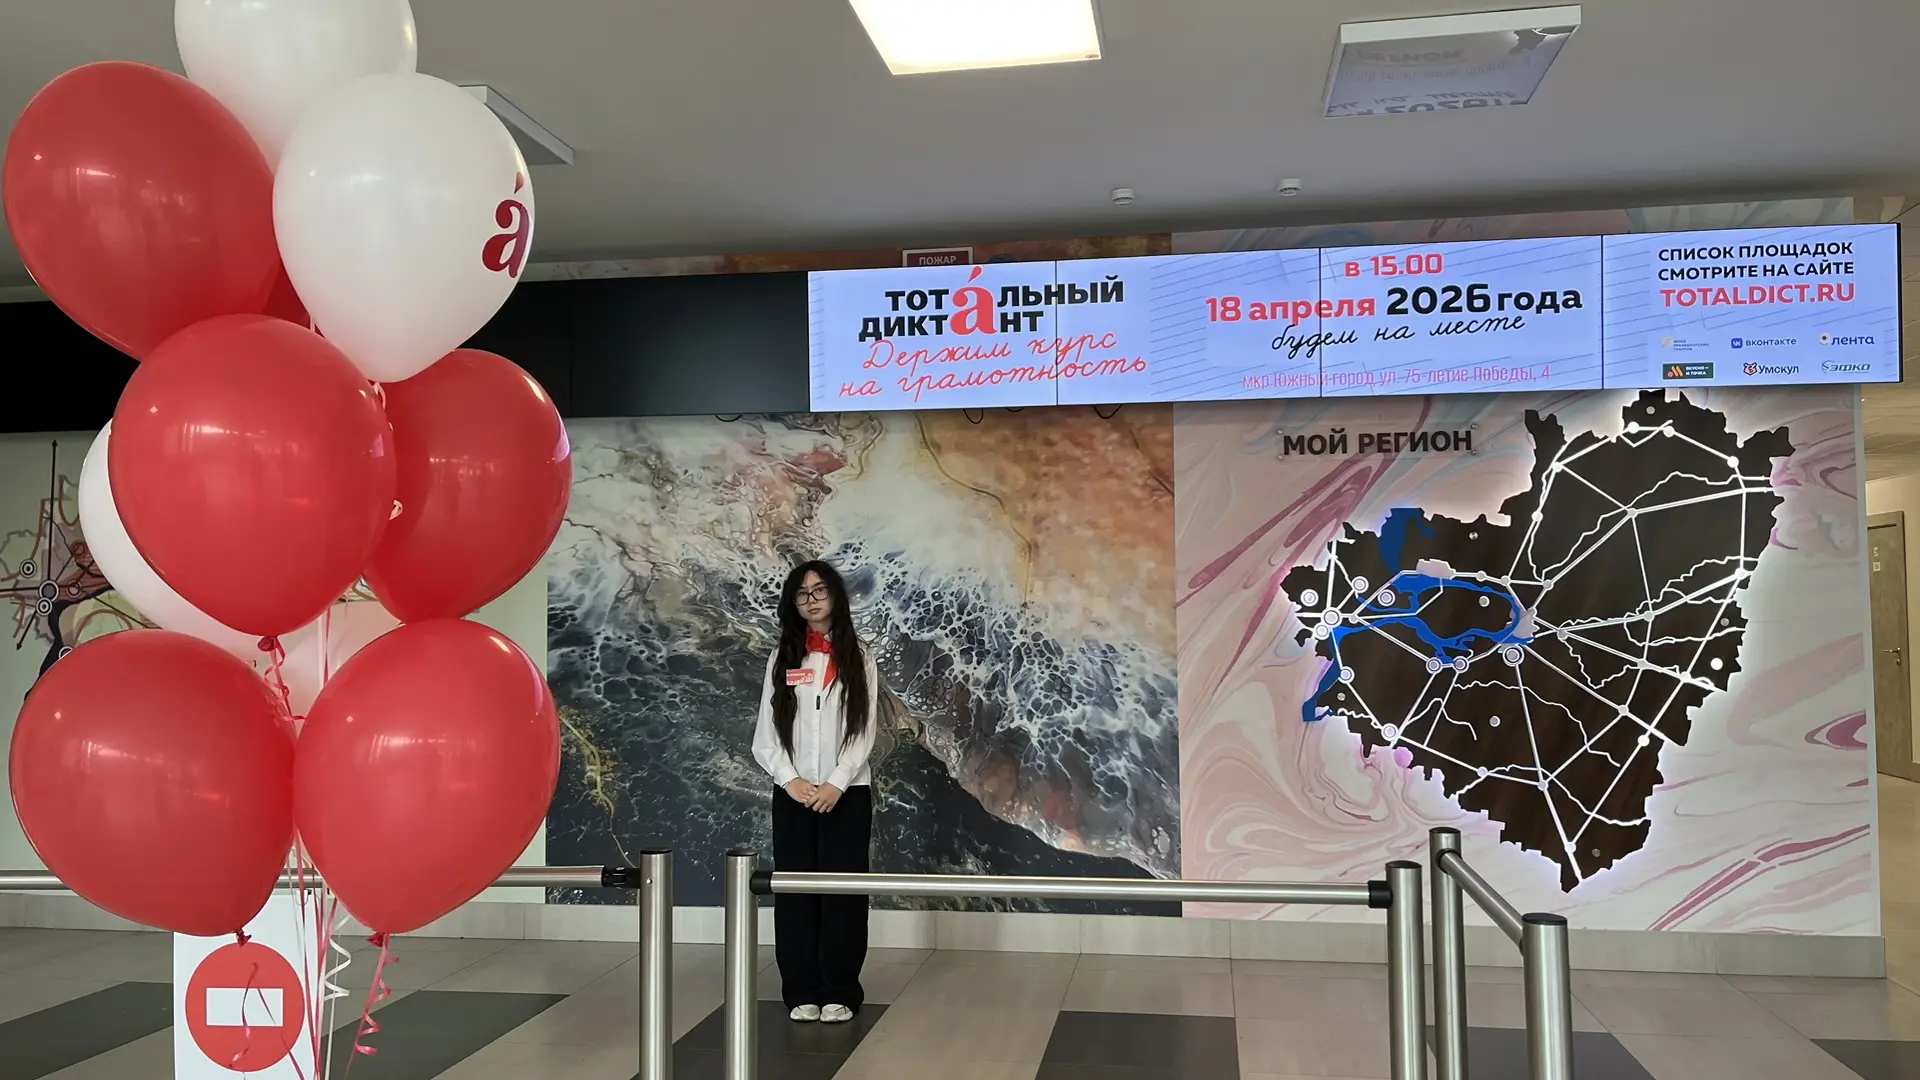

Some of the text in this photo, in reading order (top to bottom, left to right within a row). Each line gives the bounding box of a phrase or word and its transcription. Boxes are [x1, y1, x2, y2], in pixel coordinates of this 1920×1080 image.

[919, 255, 957, 266] ПОЖАР
[1658, 242, 1853, 261] СПИСОК ПЛОЩАДОК
[1344, 253, 1443, 277] в 15.00
[1658, 259, 1854, 281] СМОТРИТЕ НА САЙТЕ
[1206, 283, 1583, 326] 18 апреля 2026 года
[1660, 282, 1855, 308] TOTALDICT.RU
[1271, 315, 1526, 359] будем на месте
[1831, 335, 1875, 345] лента
[863, 332, 1118, 377] Держим курс
[839, 356, 1148, 403] на грамотность
[1332, 371, 1376, 387] город
[1380, 371, 1400, 386] ул.
[1404, 367, 1469, 384] 75-летие
[1543, 365, 1551, 379] 4
[1758, 364, 1800, 375] Умскул
[1283, 428, 1472, 455] МОЙ РЕГИОН
